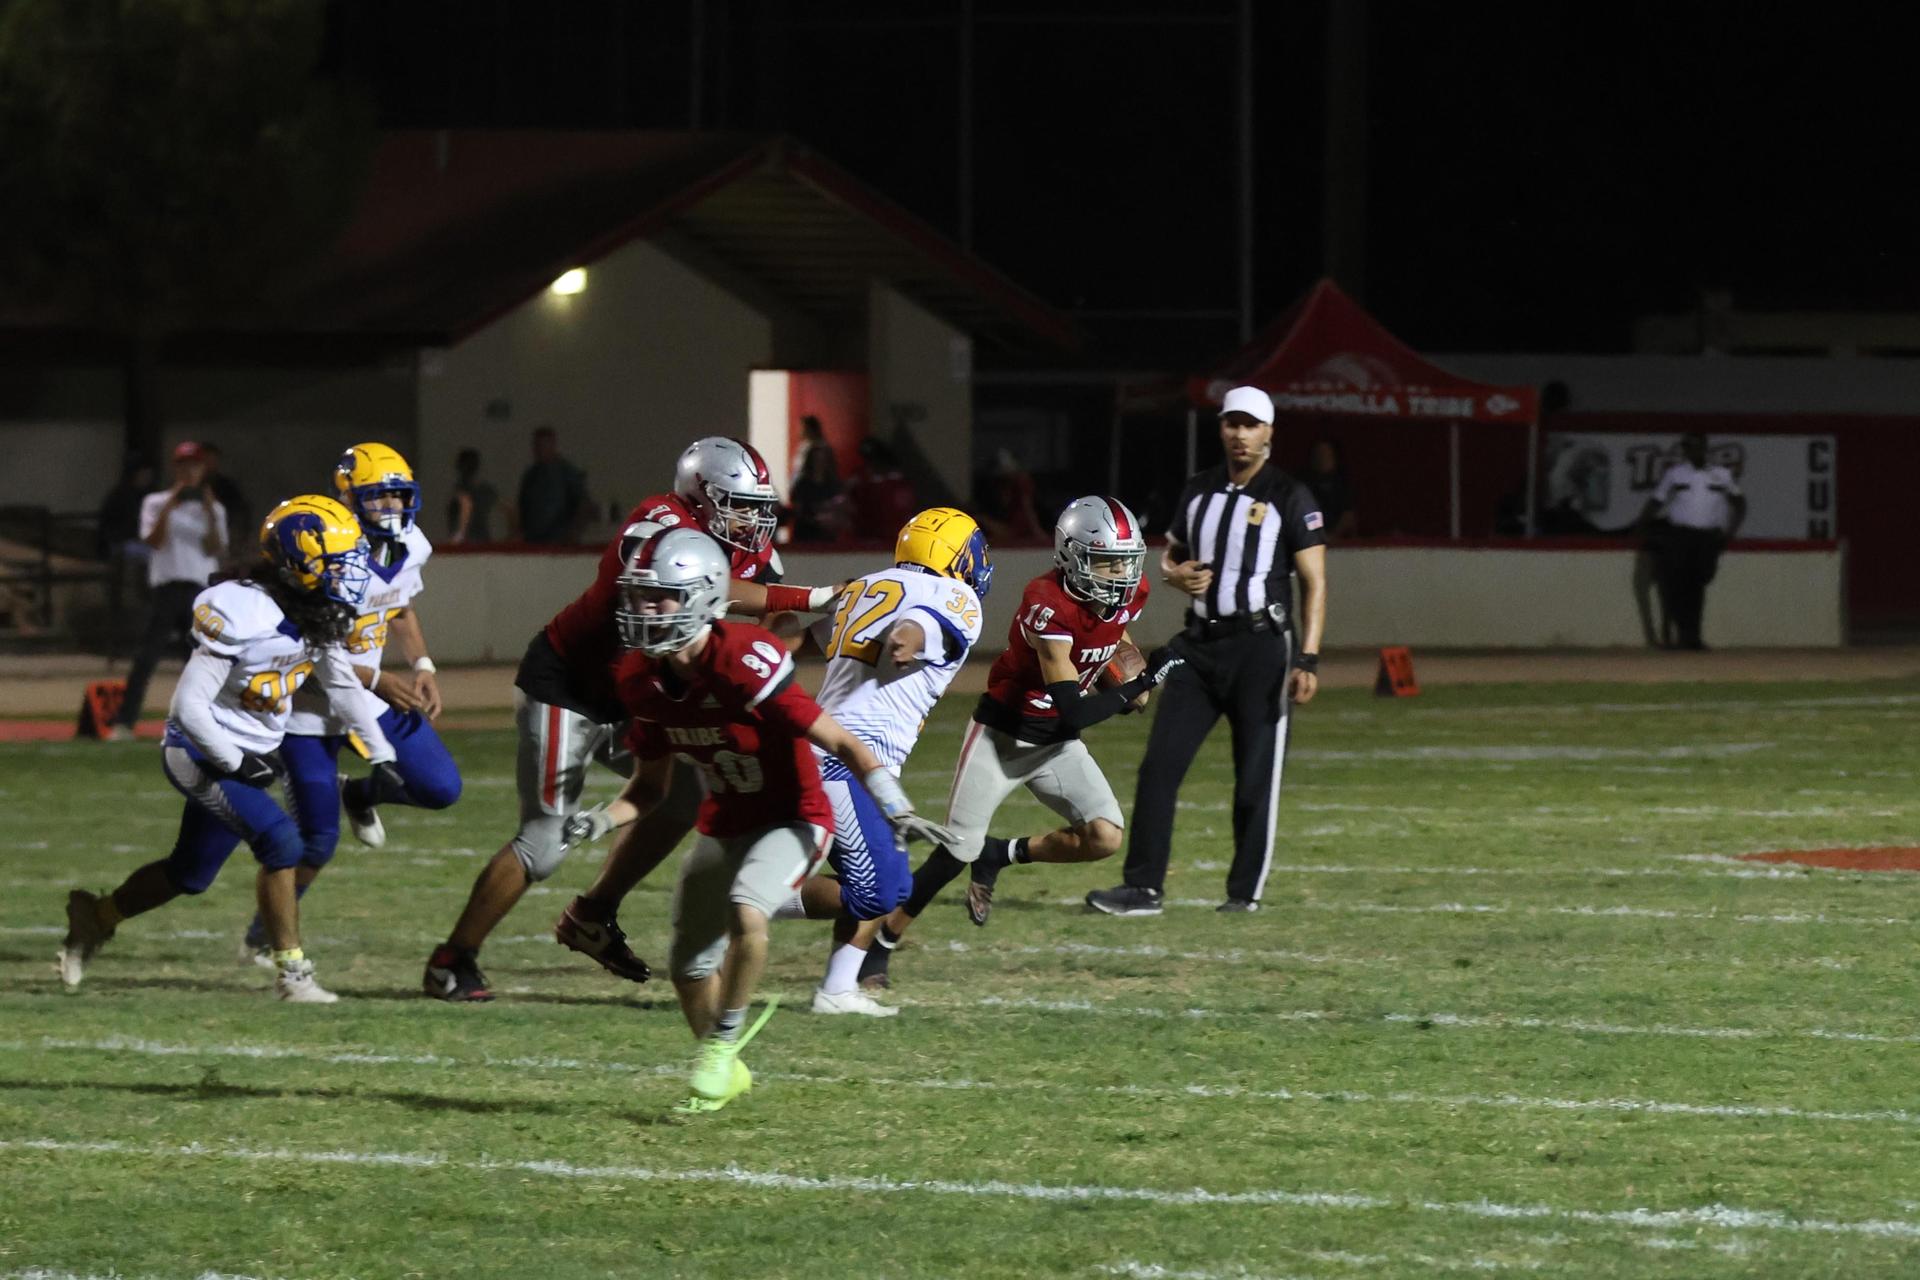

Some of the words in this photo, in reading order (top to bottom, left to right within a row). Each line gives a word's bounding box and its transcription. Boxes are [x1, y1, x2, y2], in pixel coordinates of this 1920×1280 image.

[824, 577, 907, 669] 32
[945, 587, 980, 629] 32
[1023, 603, 1055, 631] 15
[664, 726, 729, 747] TRIBE
